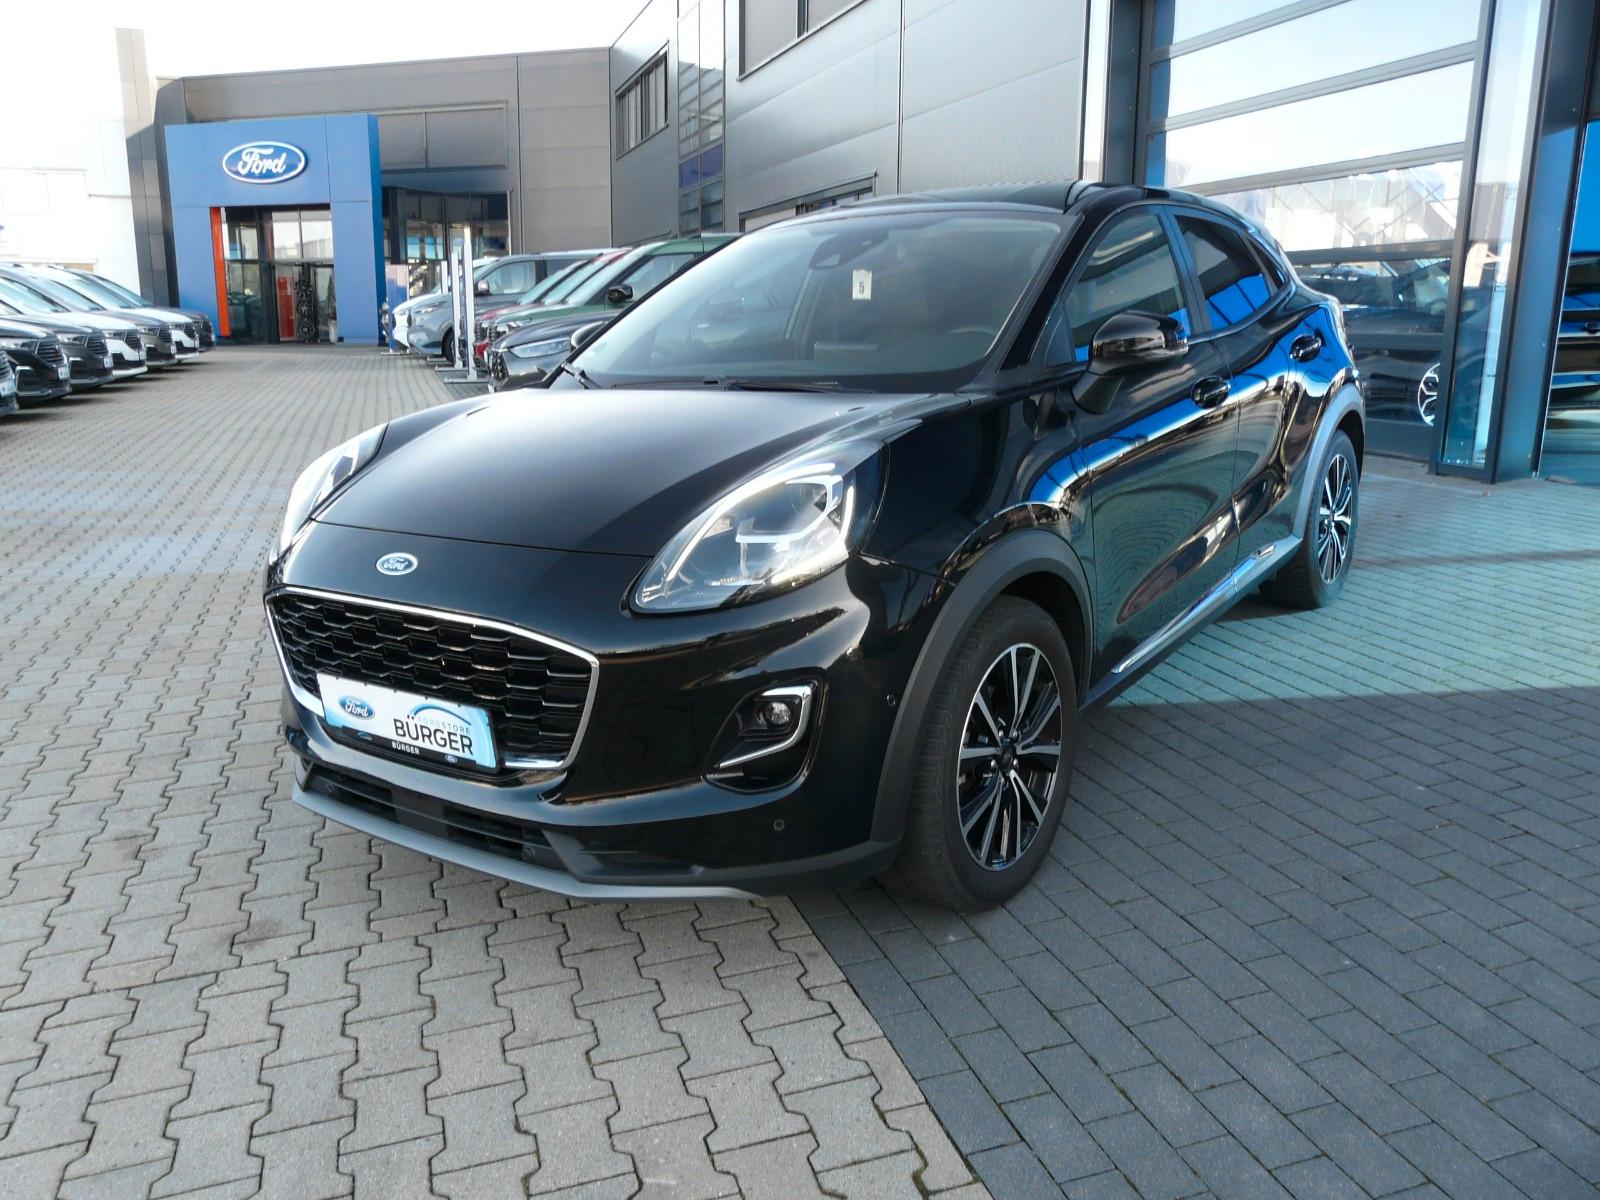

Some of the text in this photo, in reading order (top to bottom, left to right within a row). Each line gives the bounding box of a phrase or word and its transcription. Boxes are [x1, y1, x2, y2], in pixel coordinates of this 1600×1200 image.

[237, 147, 287, 175] Ford
[383, 557, 409, 571] Ford
[344, 698, 369, 717] Ford
[393, 714, 474, 756] BÜRGER
[391, 740, 420, 756] BÜRGER
